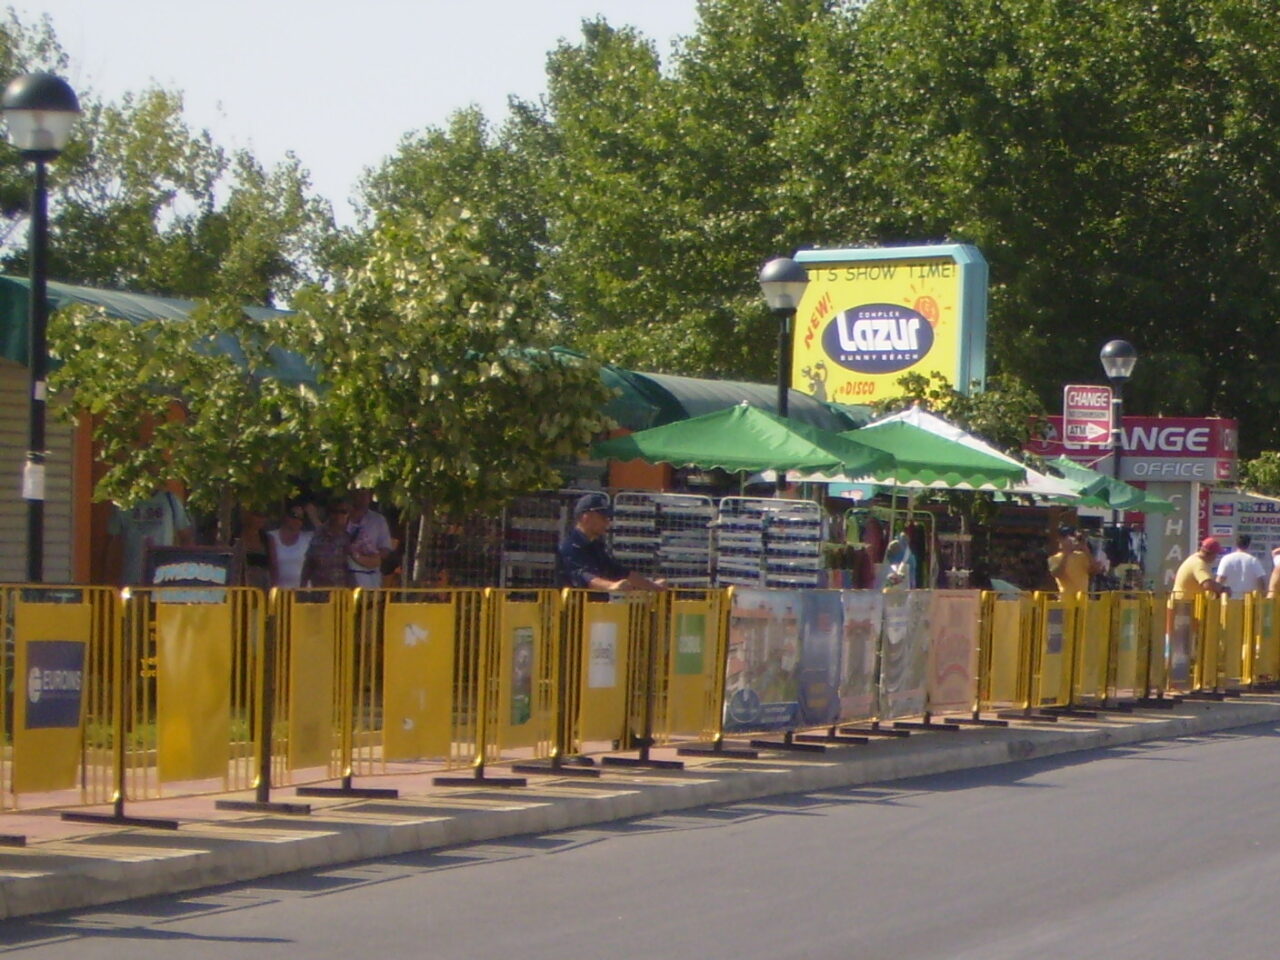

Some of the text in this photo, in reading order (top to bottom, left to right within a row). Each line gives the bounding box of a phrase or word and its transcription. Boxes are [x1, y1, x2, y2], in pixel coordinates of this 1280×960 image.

[845, 264, 896, 281] SHOW
[907, 262, 956, 278] TIME!
[804, 291, 834, 350] NEW!
[858, 310, 900, 319] COMPLEX
[836, 310, 920, 352] Lazur
[881, 353, 919, 361] BEACH
[845, 381, 875, 396] DISCO
[1068, 391, 1109, 407] CHANGE
[1069, 425, 1087, 435] ATM
[1133, 462, 1205, 477] OFFICE
